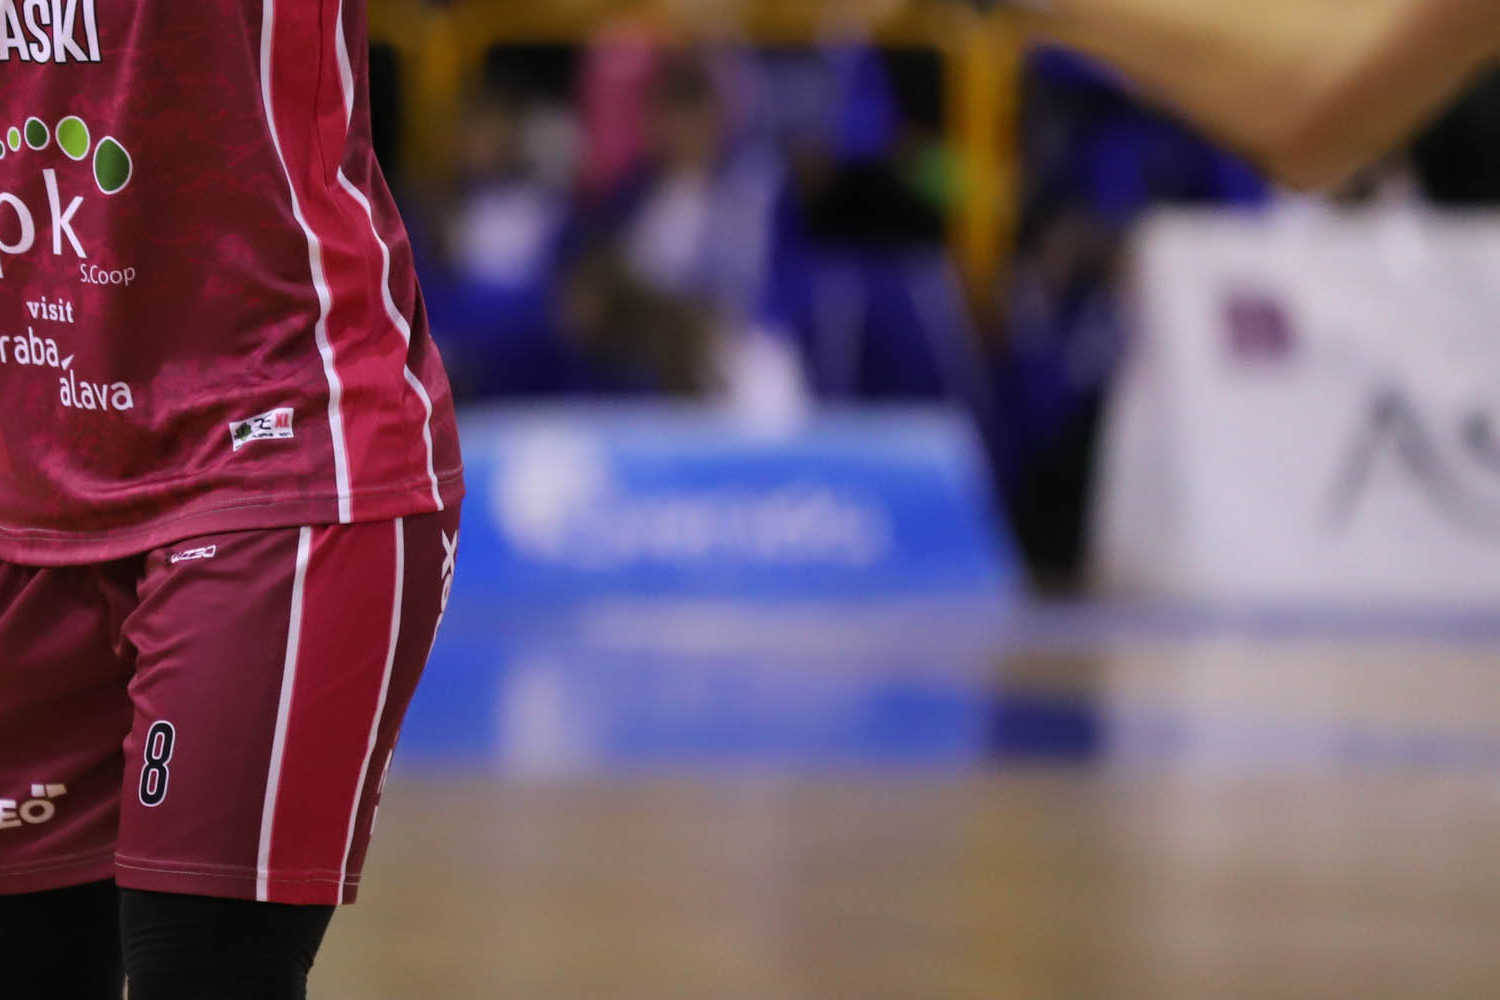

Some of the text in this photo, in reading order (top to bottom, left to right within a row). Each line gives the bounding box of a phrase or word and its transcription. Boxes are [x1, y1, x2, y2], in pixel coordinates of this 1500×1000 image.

[80, 263, 136, 286] S.Coop
[26, 296, 74, 323] visit
[139, 720, 176, 807] 8
